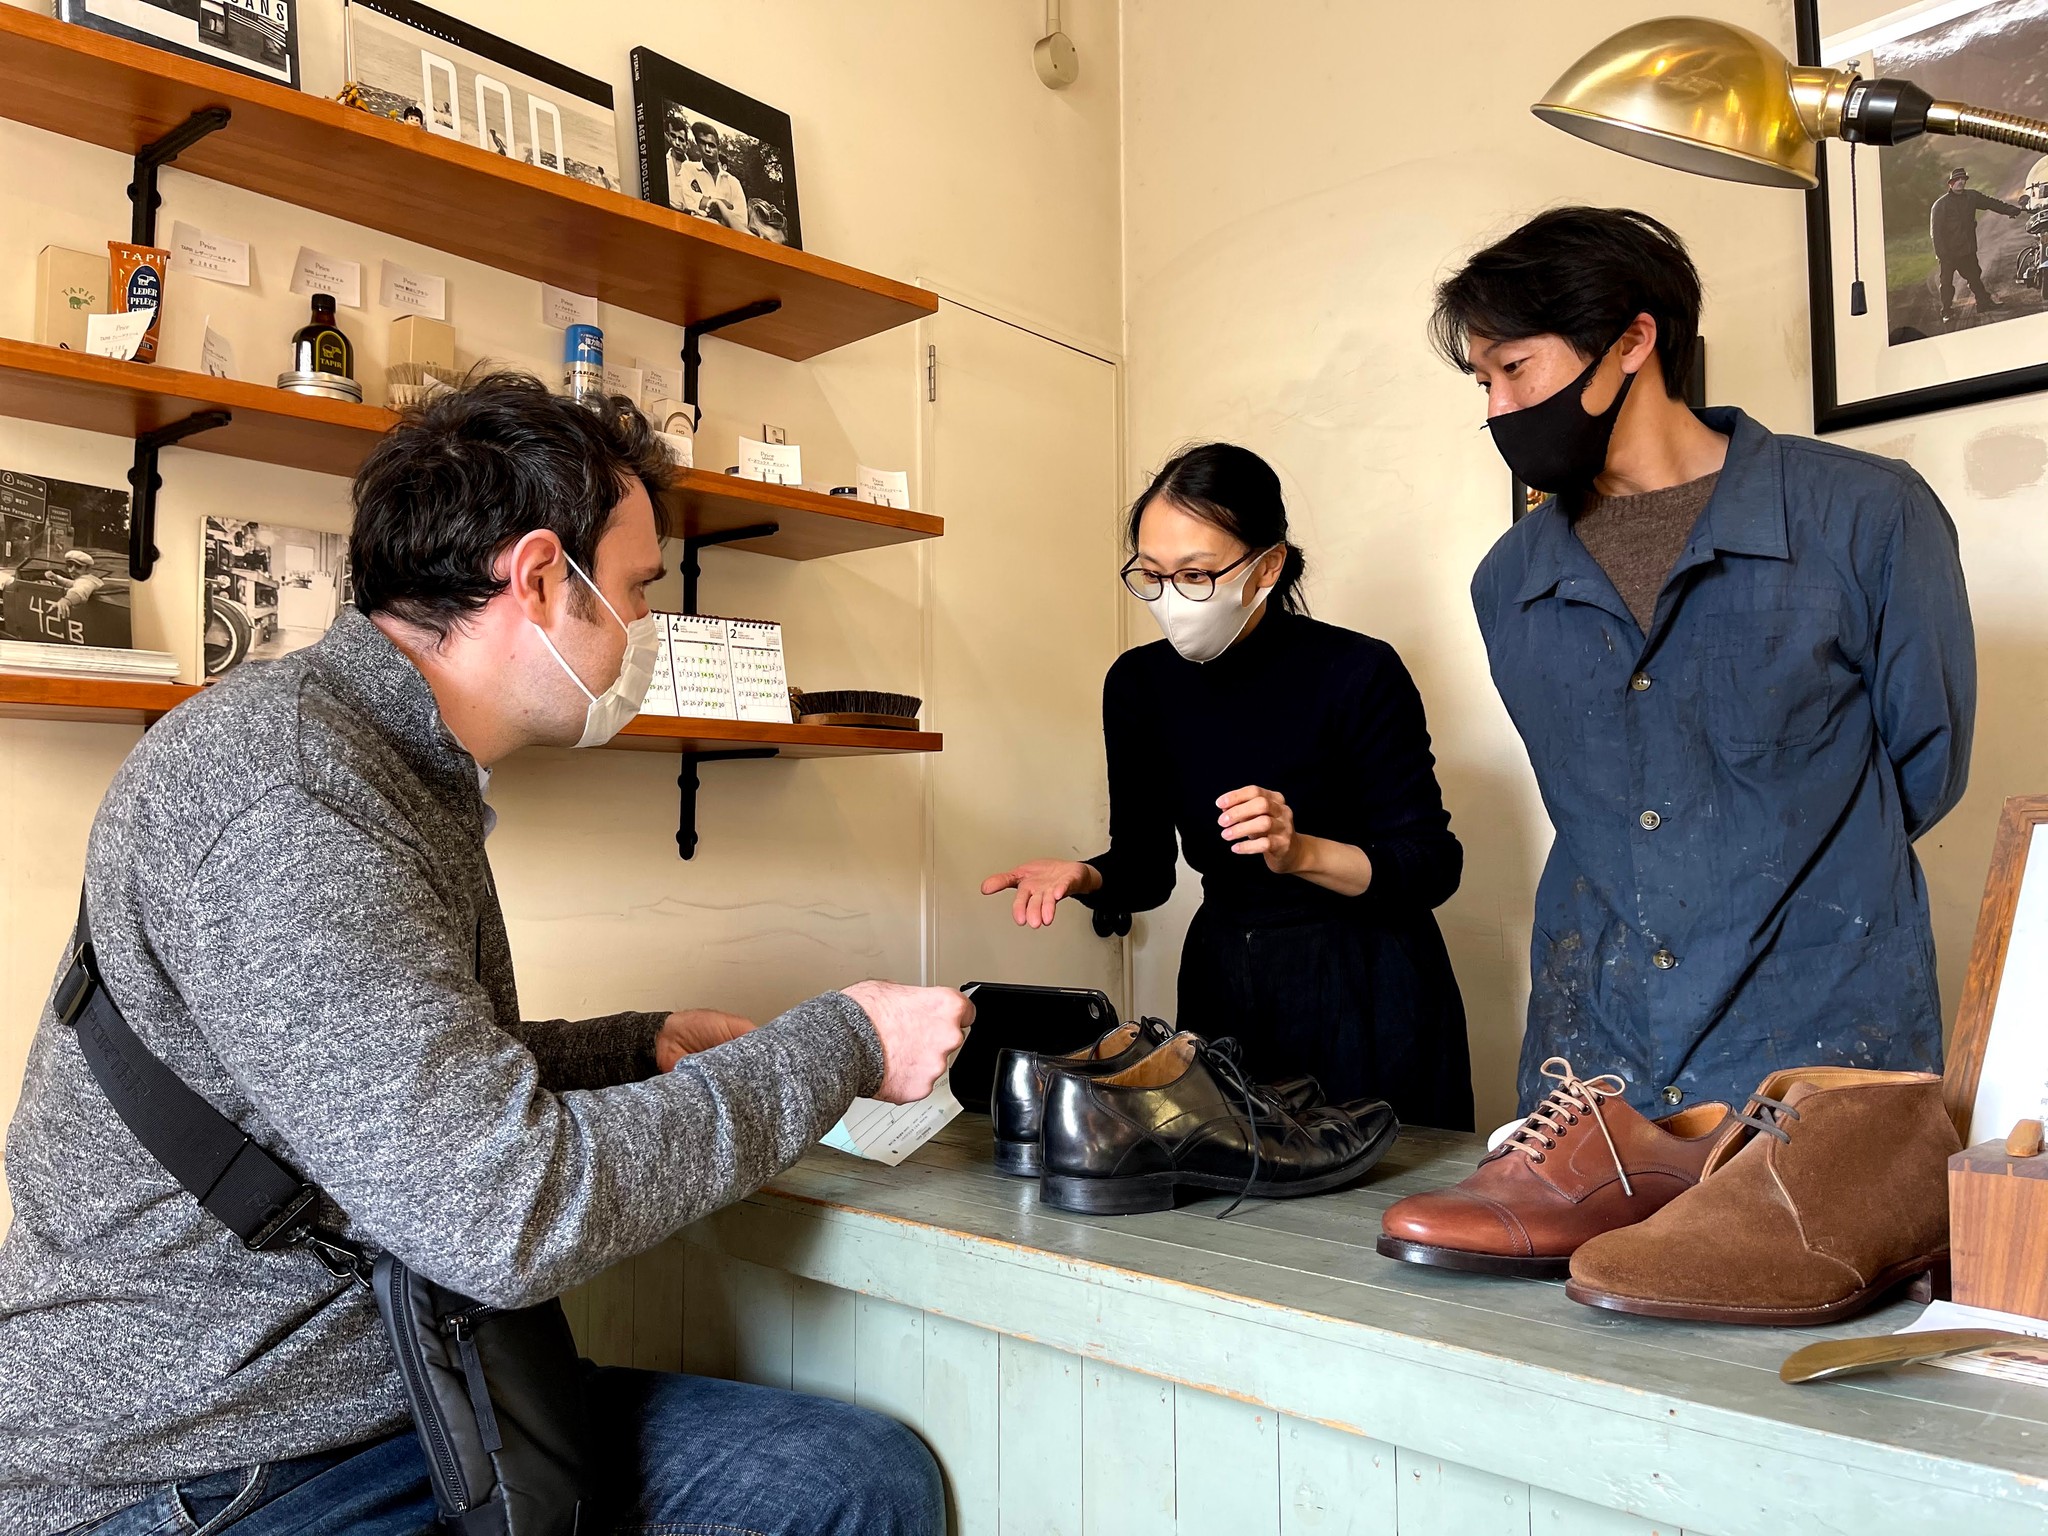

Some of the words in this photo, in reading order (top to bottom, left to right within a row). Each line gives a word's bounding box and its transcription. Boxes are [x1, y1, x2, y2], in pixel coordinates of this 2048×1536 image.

[230, 0, 285, 21] ANS
[640, 144, 647, 155] OF
[61, 287, 95, 302] TAPIR
[133, 287, 157, 297] LEDER
[130, 297, 158, 307] PFLEGE
[321, 358, 342, 368] TAPIR
[15, 498, 29, 506] WEST
[672, 623, 679, 632] 4
[730, 629, 737, 638] 2
